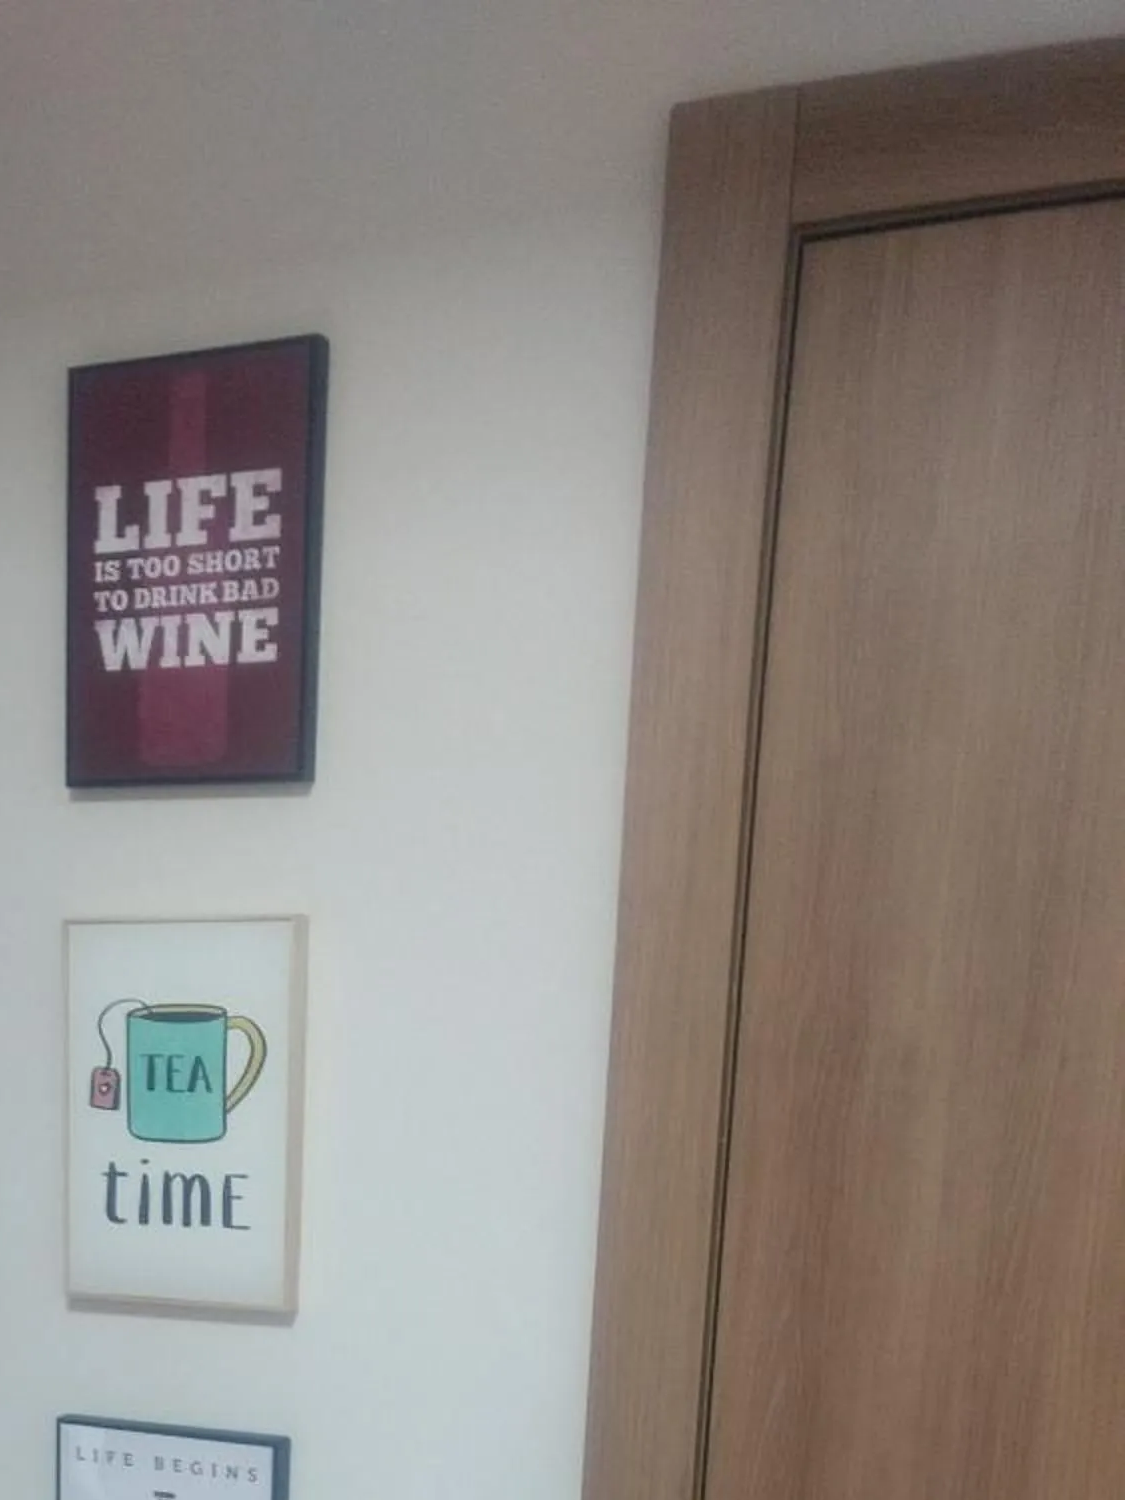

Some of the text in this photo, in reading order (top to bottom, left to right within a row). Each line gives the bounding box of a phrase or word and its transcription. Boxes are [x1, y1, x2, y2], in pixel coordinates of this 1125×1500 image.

[94, 468, 282, 554] LIFE
[94, 546, 280, 583] IS TOO SHORT
[93, 578, 280, 612] TO DRINK BAD
[93, 607, 279, 672] WINE
[140, 1053, 214, 1094] TEA
[75, 1445, 259, 1483] LIFE BEGINS
